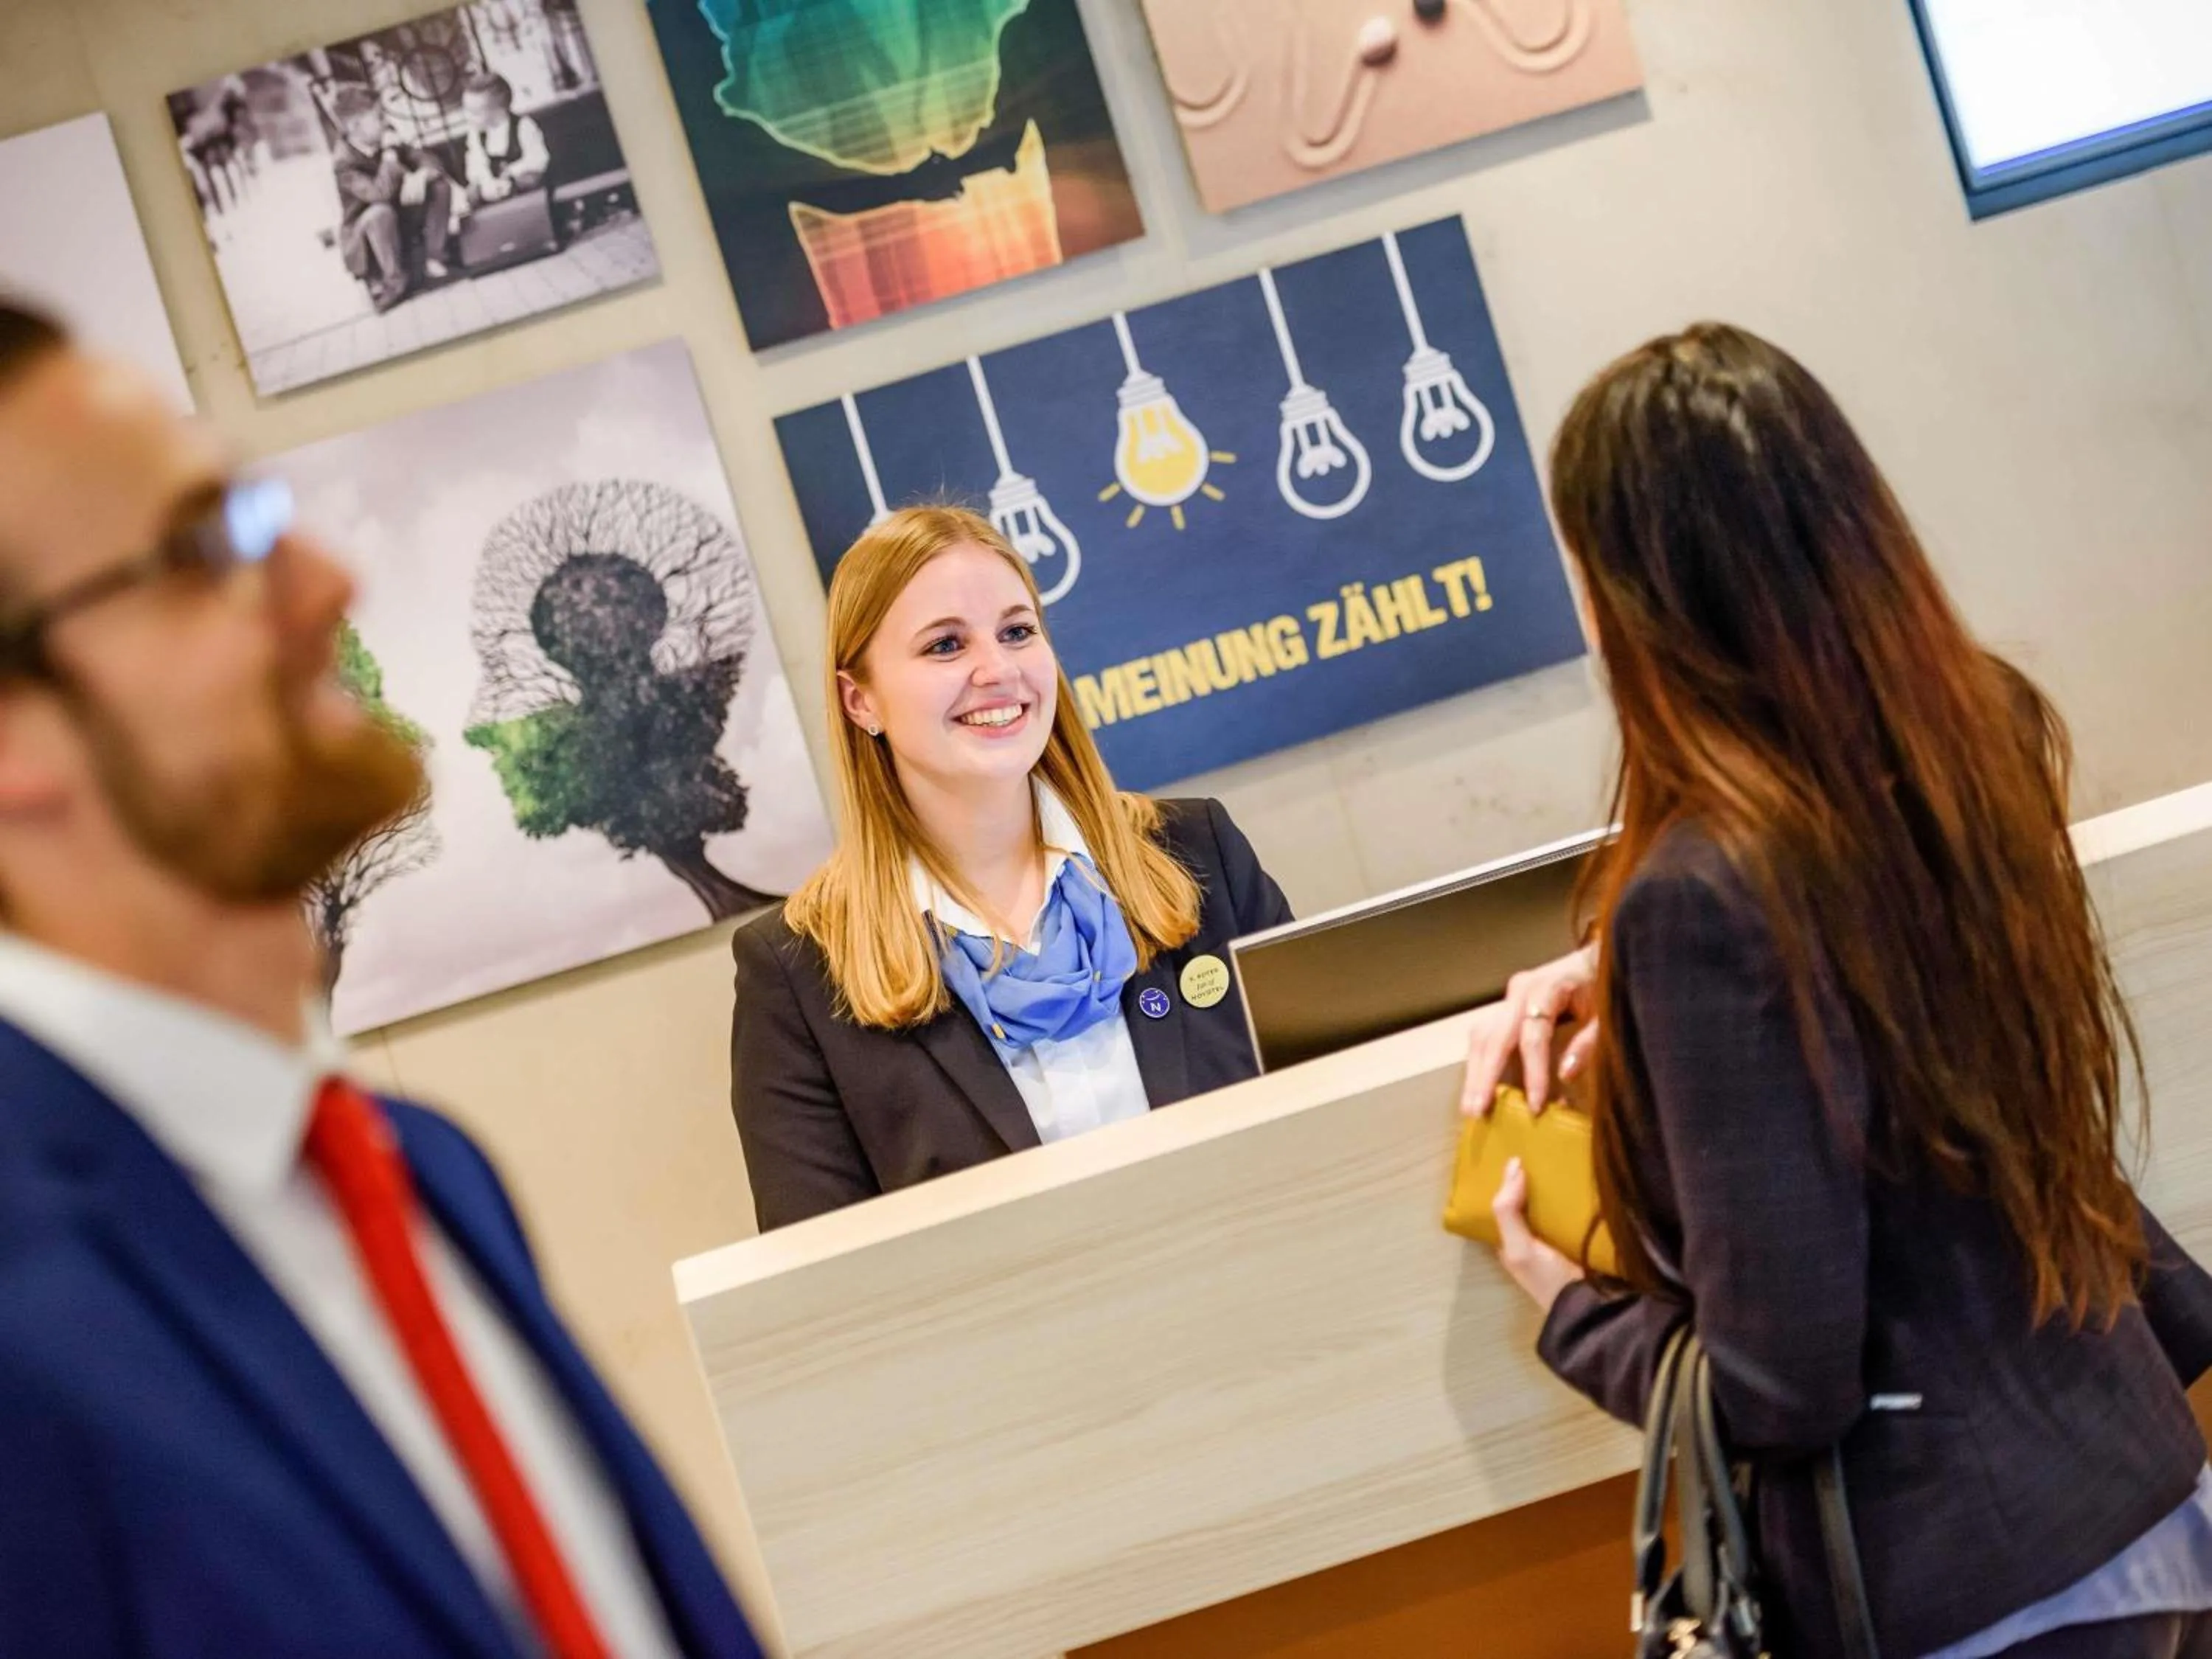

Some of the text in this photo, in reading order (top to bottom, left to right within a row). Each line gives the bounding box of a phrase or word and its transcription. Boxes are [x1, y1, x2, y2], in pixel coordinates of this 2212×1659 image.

[1074, 555, 1493, 729] MEINUNG ZÄHLT!
[1150, 1002, 1161, 1012] N
